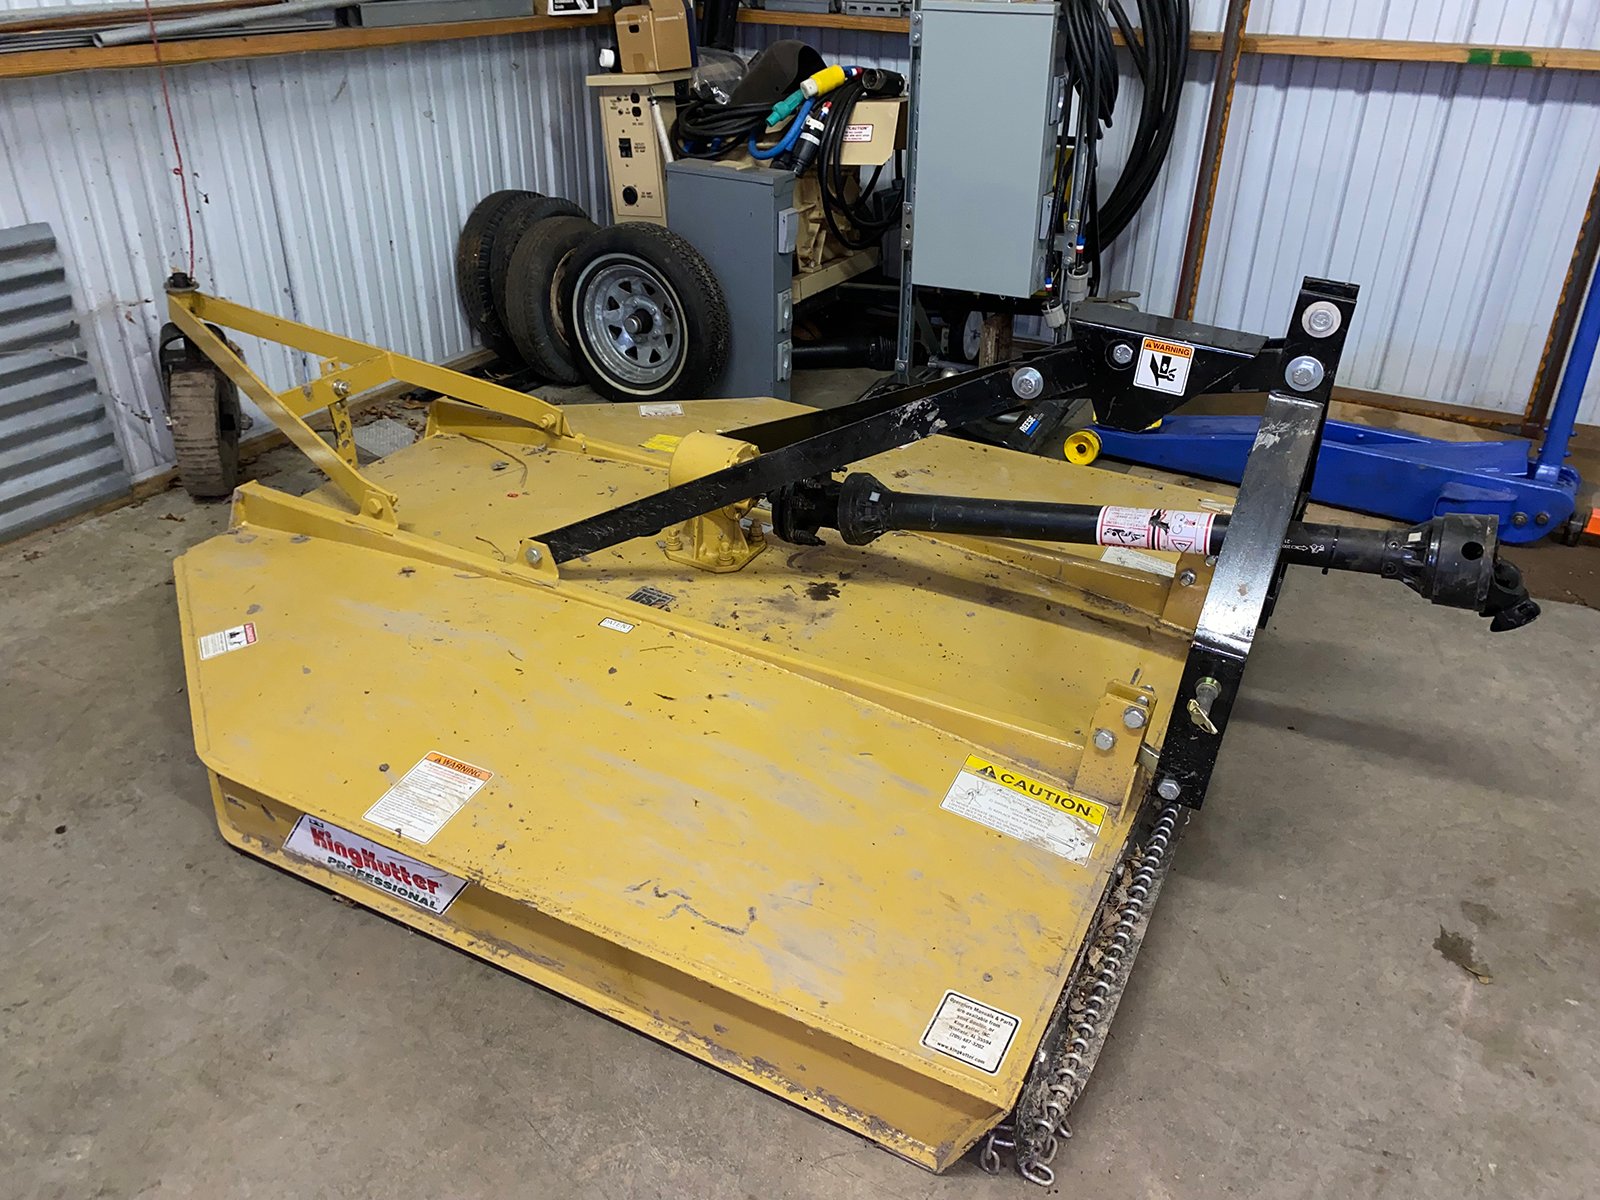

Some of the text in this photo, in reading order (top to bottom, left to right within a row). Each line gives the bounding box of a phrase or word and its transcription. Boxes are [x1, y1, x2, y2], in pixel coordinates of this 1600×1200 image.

[1153, 342, 1190, 355] WARNING
[1019, 415, 1036, 433] REESE
[442, 758, 482, 777] WARNING
[1000, 774, 1092, 816] CAUTION
[327, 856, 438, 910] PROFESSIONAL
[954, 1020, 964, 1028] King
[966, 1010, 988, 1023] available
[988, 1020, 1000, 1028] from
[974, 1007, 994, 1018] Manuals
[1000, 1018, 1013, 1026] Parts
